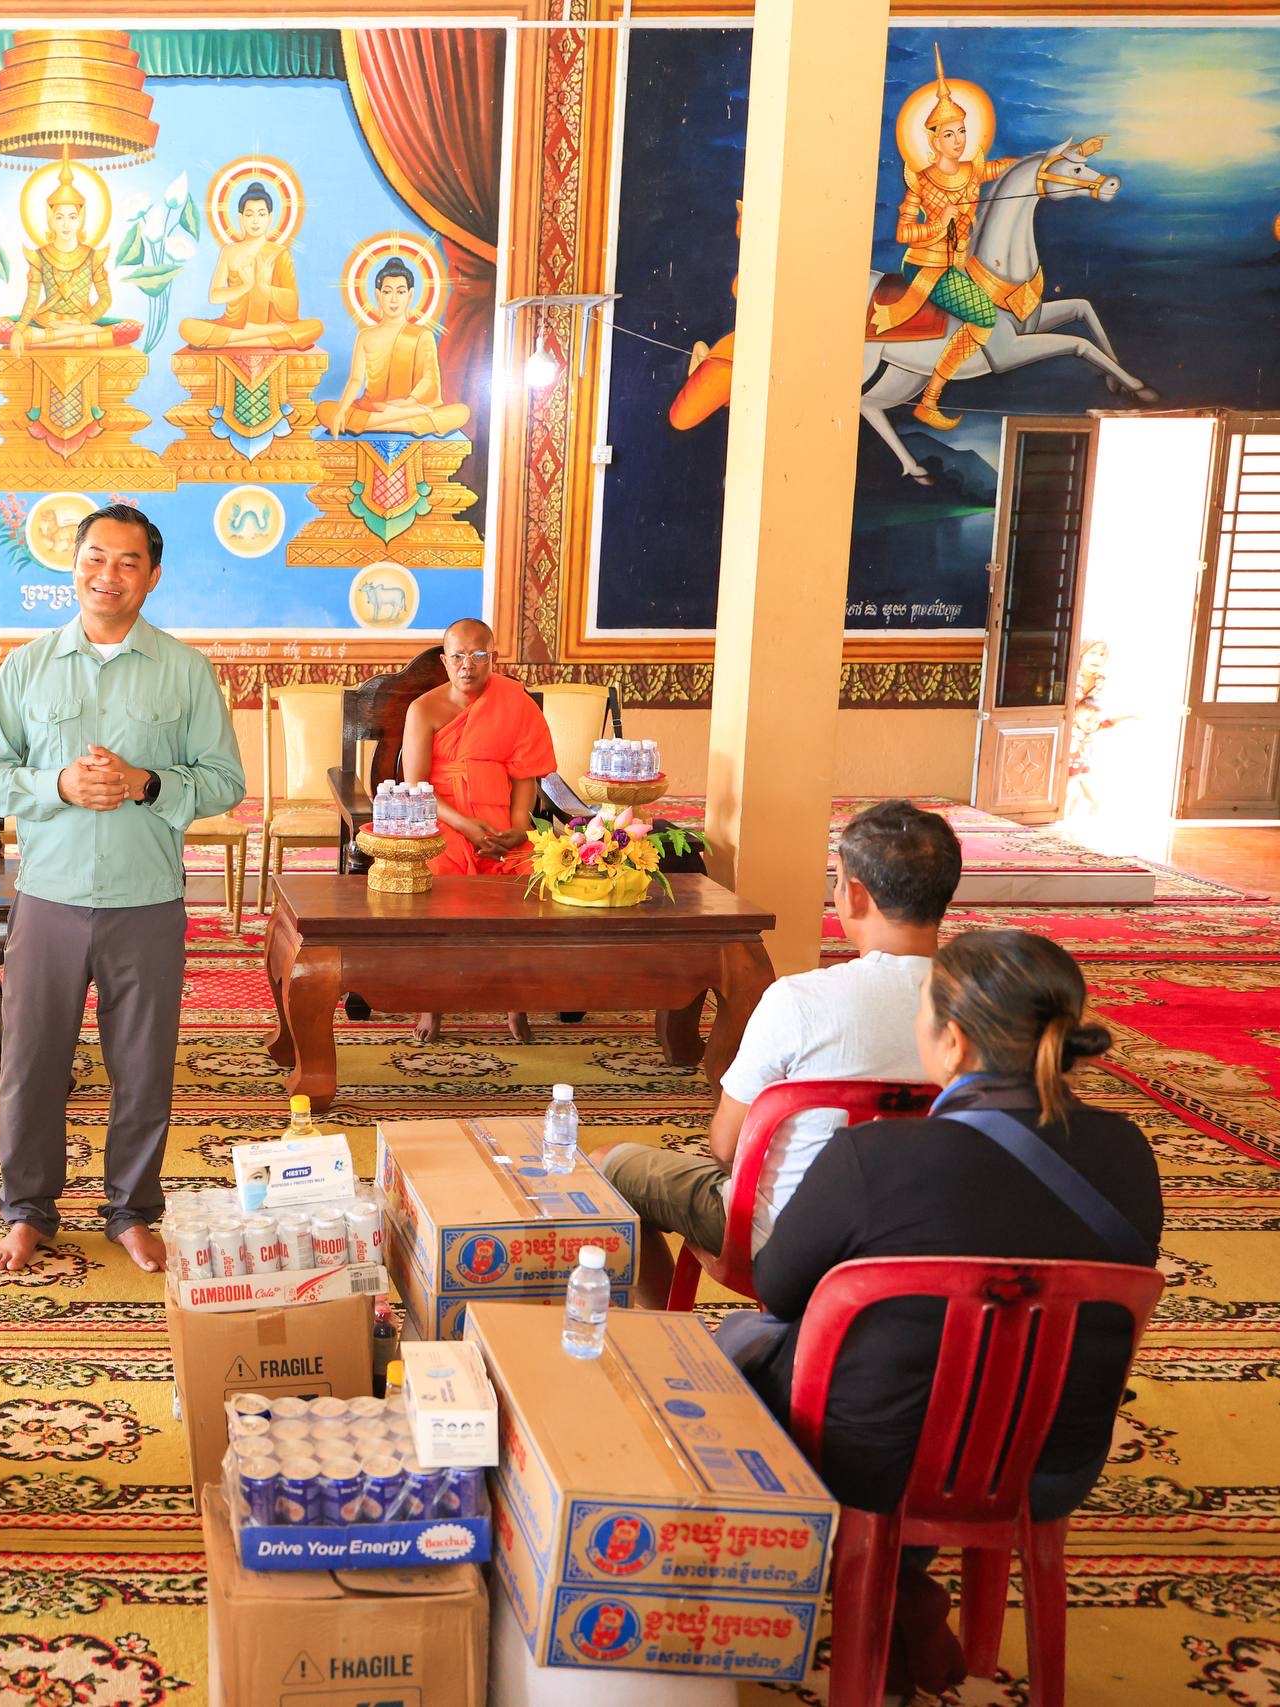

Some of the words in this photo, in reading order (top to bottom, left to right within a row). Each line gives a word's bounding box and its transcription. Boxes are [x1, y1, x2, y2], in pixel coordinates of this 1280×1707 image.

[285, 1168, 309, 1177] HESTIS
[313, 1236, 347, 1253] MBODI
[190, 1284, 253, 1306] CAMBODIA
[260, 1356, 324, 1378] FRAGILE
[258, 1540, 303, 1556] Drive
[307, 1541, 347, 1556] Your
[349, 1538, 412, 1557] Energy
[329, 1654, 413, 1680] FRAGILE
